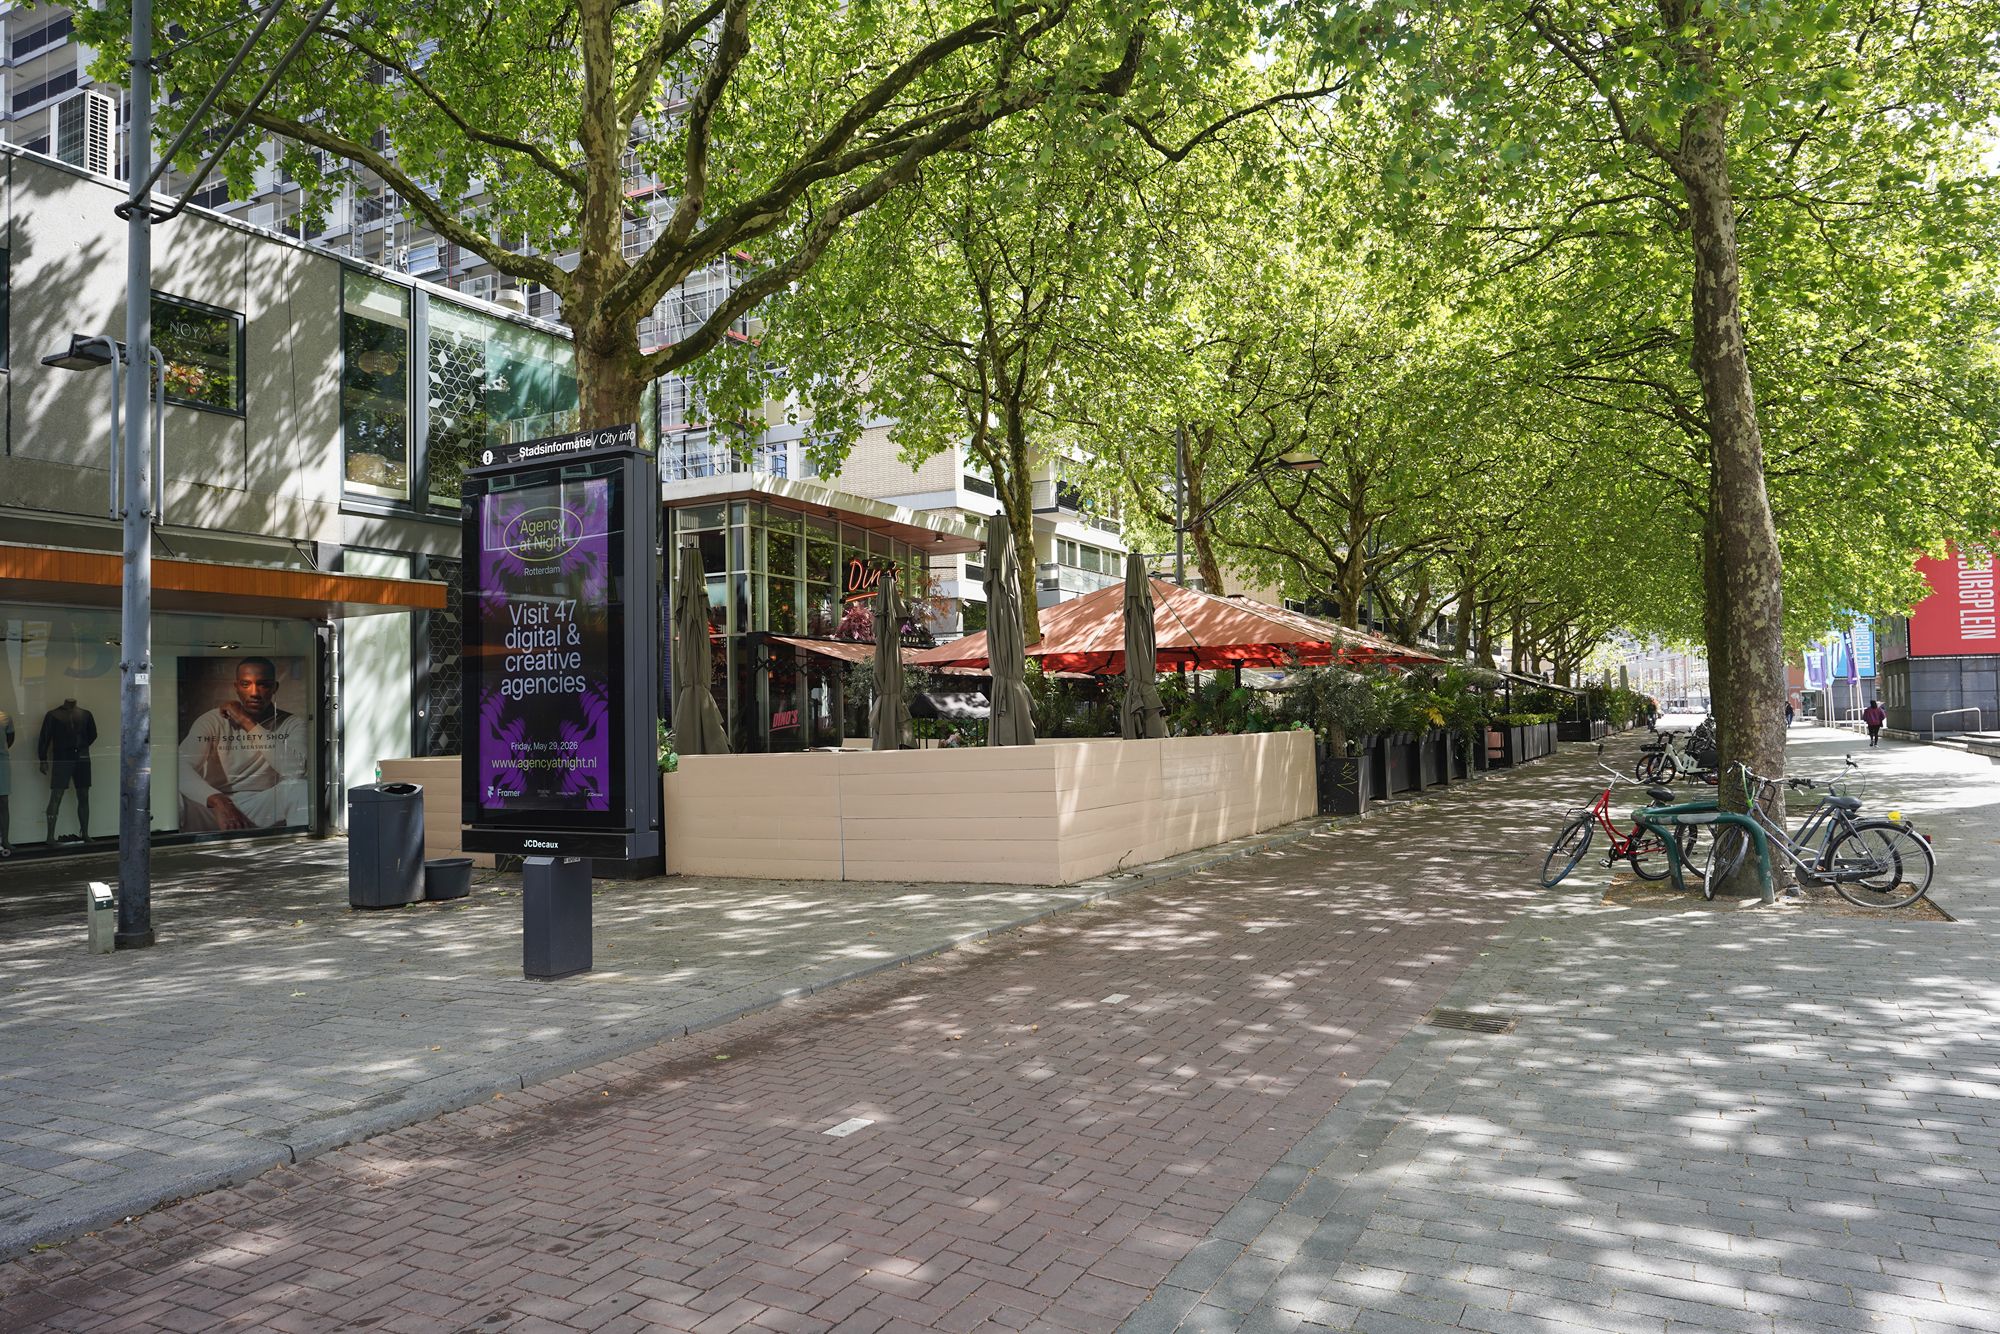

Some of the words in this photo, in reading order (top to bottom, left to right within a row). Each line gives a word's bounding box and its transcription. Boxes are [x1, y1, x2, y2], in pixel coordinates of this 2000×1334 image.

[169, 321, 212, 345] NOYA
[519, 438, 592, 458] Stadsinformatie
[600, 433, 617, 445] City
[619, 430, 636, 442] info
[520, 518, 566, 537] Agency
[520, 538, 532, 552] at
[534, 534, 566, 552] Night
[524, 565, 561, 576] Rotterdam
[509, 602, 549, 626] Visit
[554, 599, 577, 622] 47
[505, 624, 561, 654] digital
[566, 623, 581, 646] &
[505, 647, 581, 673] creative
[501, 670, 586, 701] agencies
[773, 709, 799, 728] DINO'S
[222, 734, 263, 742] SOCIETY
[266, 733, 290, 741] SHOP
[511, 742, 533, 752] Friday,
[533, 742, 548, 752] May
[560, 741, 578, 750] 2026
[491, 756, 597, 771] www.agencyatnight.nl
[497, 788, 521, 797] Framer
[523, 839, 559, 849] JCDecaux
